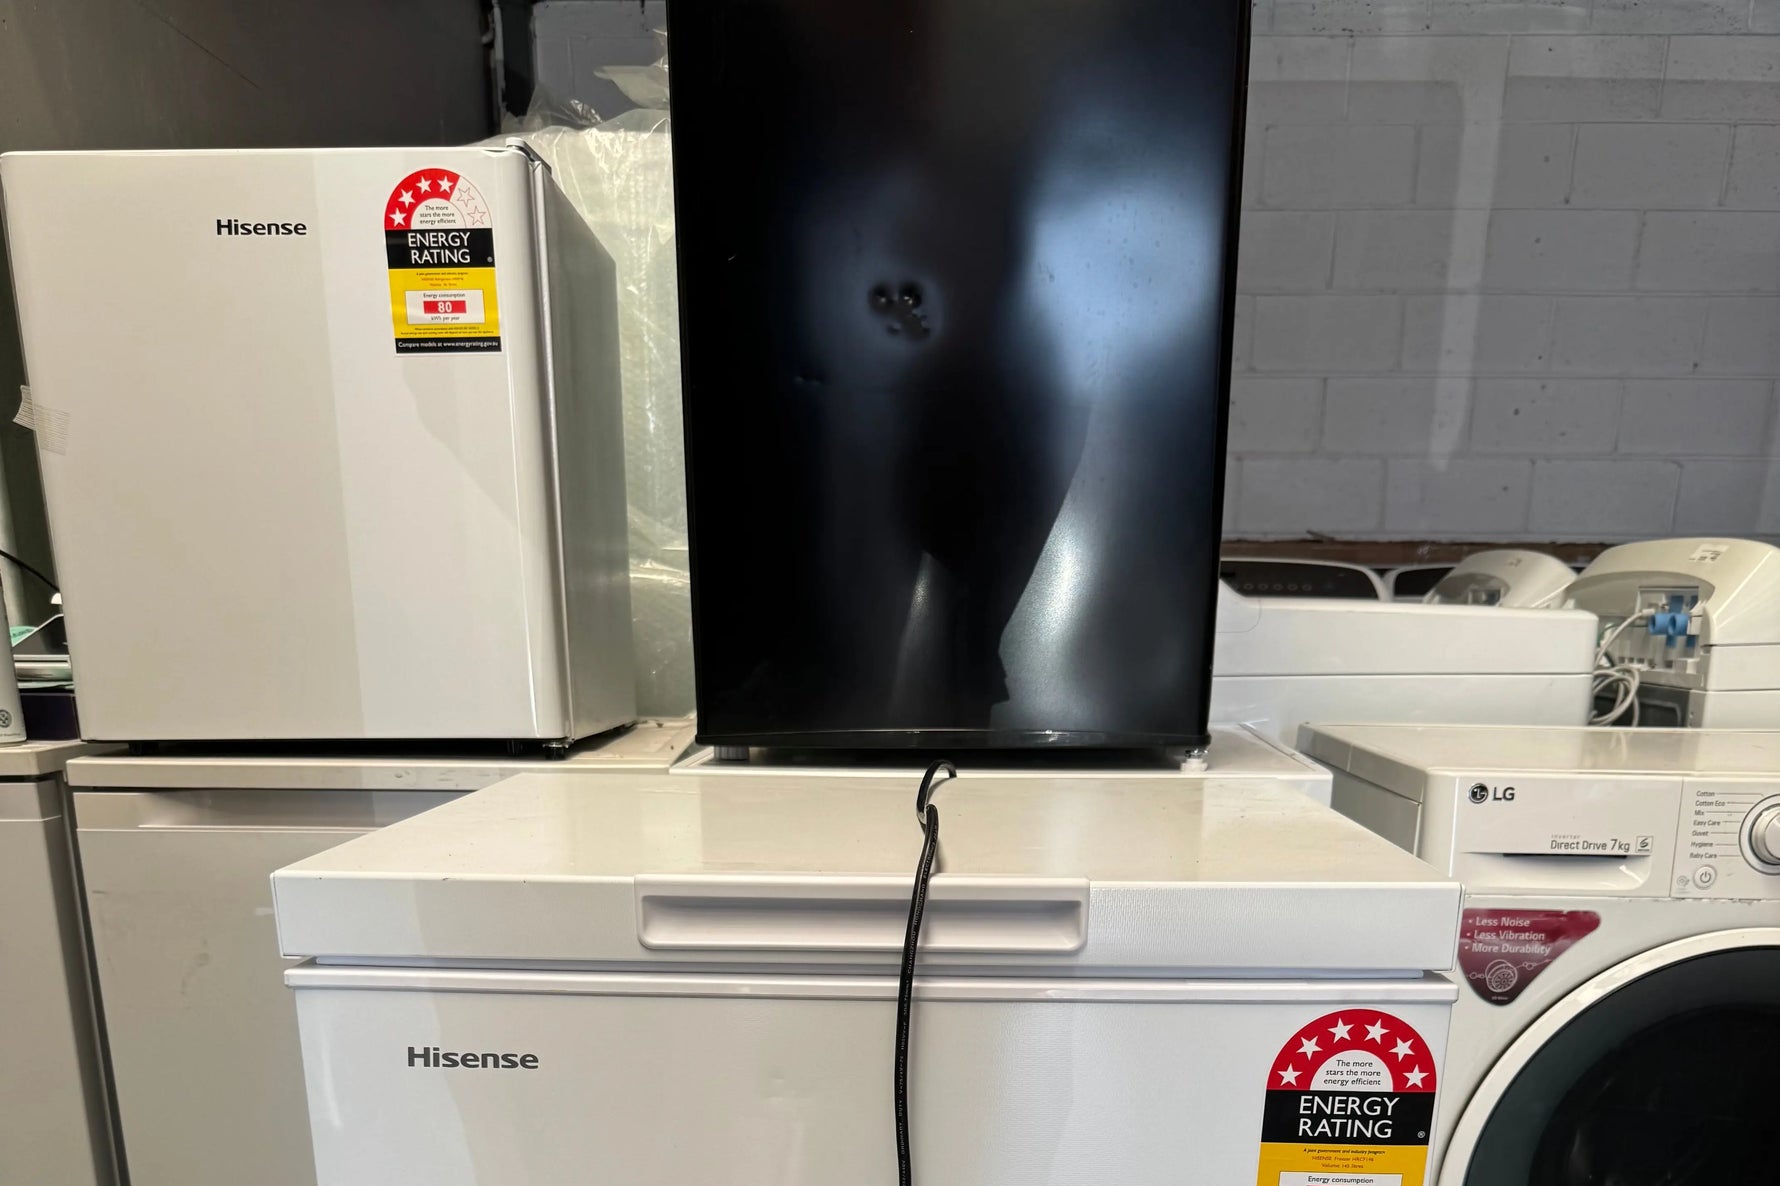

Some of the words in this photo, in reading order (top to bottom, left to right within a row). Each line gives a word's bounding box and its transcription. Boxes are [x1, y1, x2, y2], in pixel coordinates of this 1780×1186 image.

[216, 218, 307, 235] Hisense
[407, 231, 471, 247] ENERGY
[411, 249, 470, 264] RATING
[438, 301, 452, 312] 80
[1492, 786, 1515, 801] LG
[1551, 840, 1580, 850] Direct
[1582, 840, 1607, 850] Drive
[1476, 917, 1498, 926] Less
[1501, 917, 1530, 927] Noise
[1474, 930, 1496, 940] Less
[1499, 930, 1545, 941] Vibration
[1471, 943, 1498, 953] More
[1501, 944, 1551, 956] Durability
[407, 1046, 539, 1069] Hisense
[1336, 1059, 1350, 1067] The
[1352, 1060, 1373, 1068] more
[1351, 1078, 1381, 1086] efficient
[1299, 1095, 1400, 1116] ENERGY
[1298, 1118, 1393, 1138] RATING
[1308, 1176, 1330, 1184] Energy
